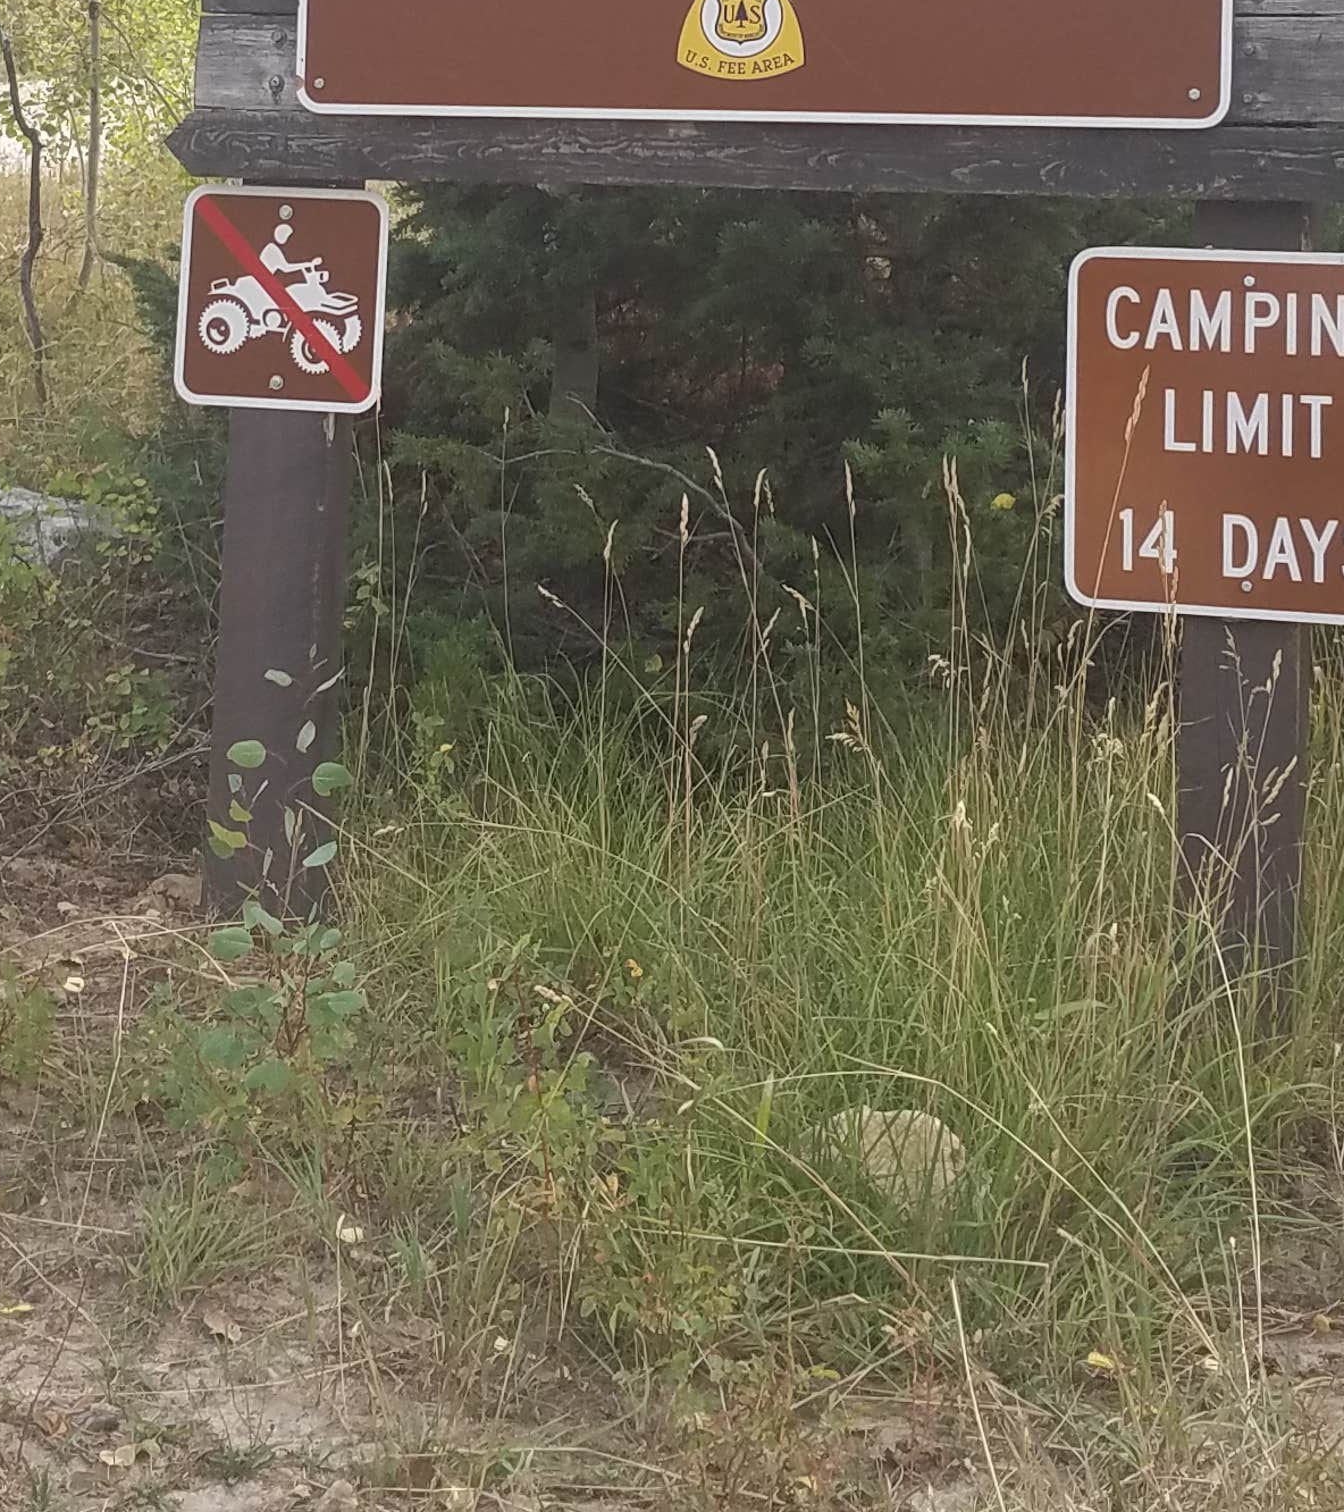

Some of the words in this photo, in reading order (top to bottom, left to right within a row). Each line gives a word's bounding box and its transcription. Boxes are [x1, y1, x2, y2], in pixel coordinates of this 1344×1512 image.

[685, 49, 712, 71] U.S.
[717, 60, 746, 75] FEE
[751, 52, 795, 75] AREA
[1164, 388, 1333, 459] LIMIT
[1118, 508, 1178, 575] 14
